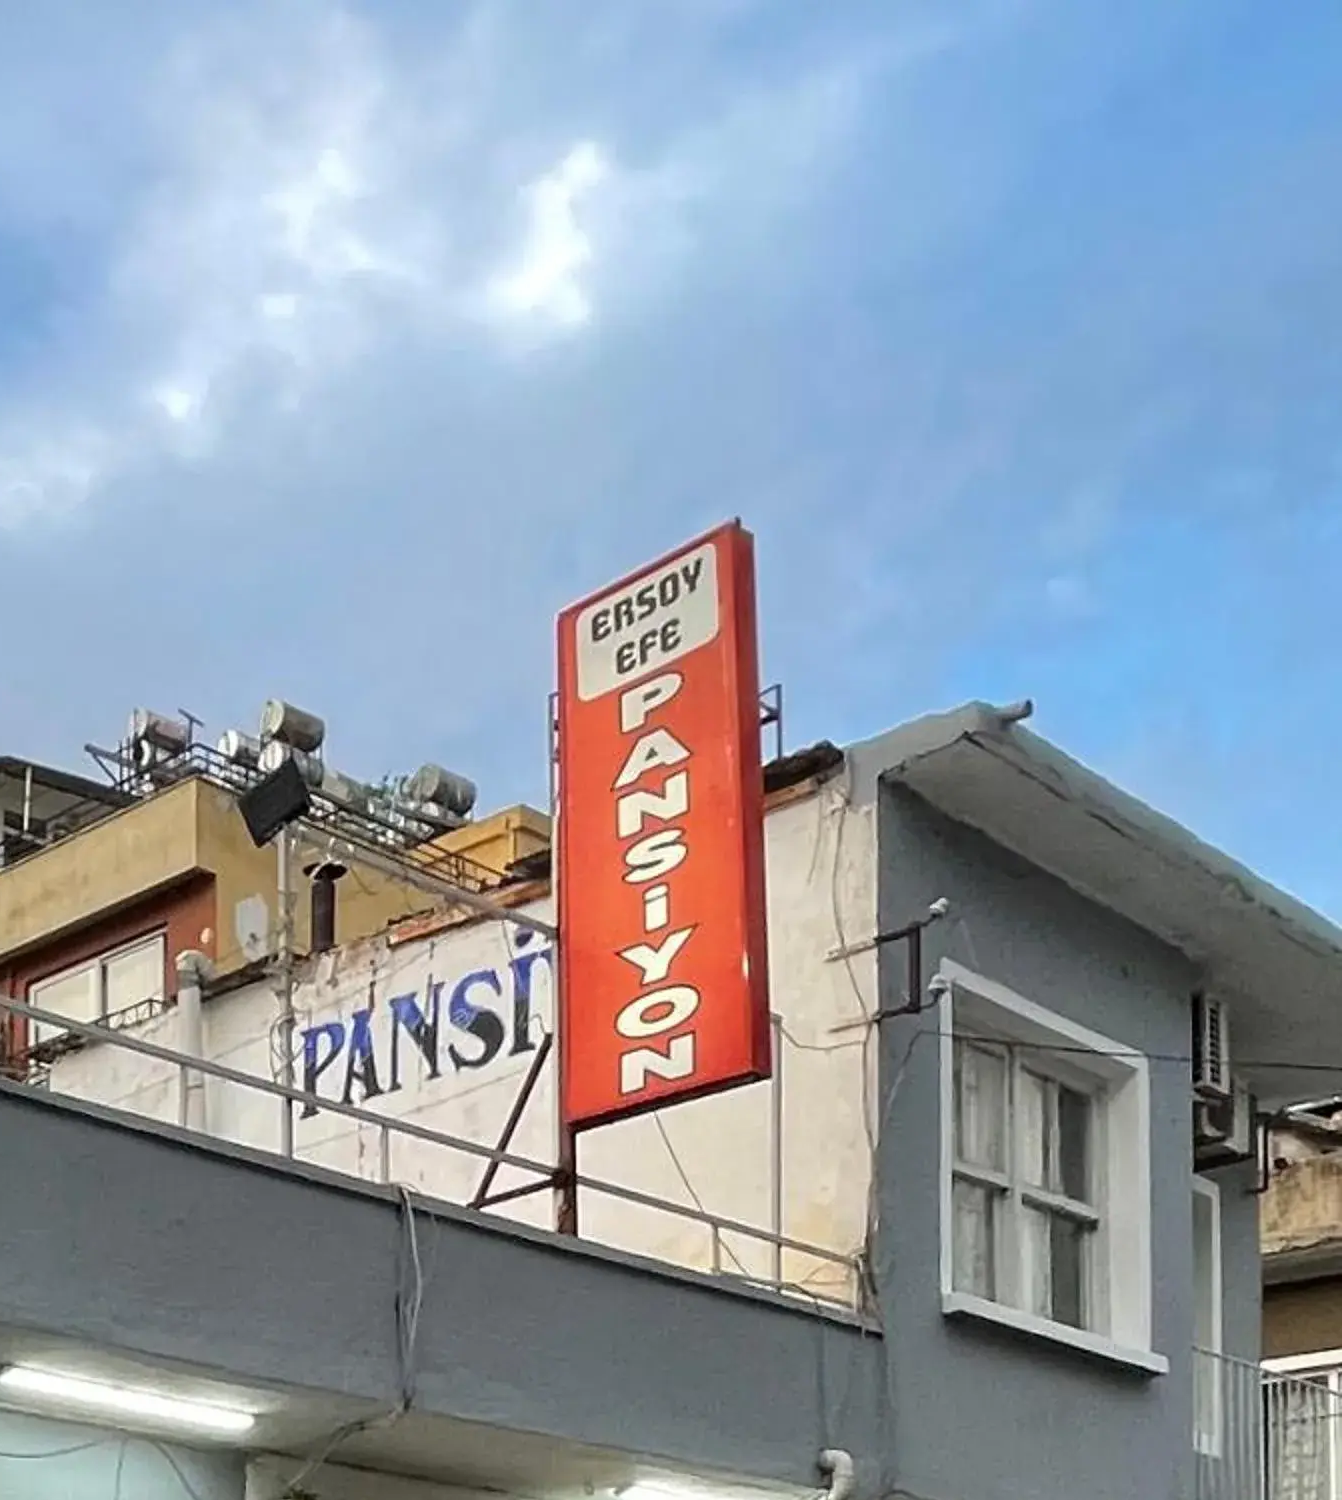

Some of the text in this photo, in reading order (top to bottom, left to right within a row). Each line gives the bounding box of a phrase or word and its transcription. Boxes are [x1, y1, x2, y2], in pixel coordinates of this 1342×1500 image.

[591, 557, 703, 642] ERSOY
[615, 618, 681, 675] EFE
[300, 928, 553, 1118] PANSİ
